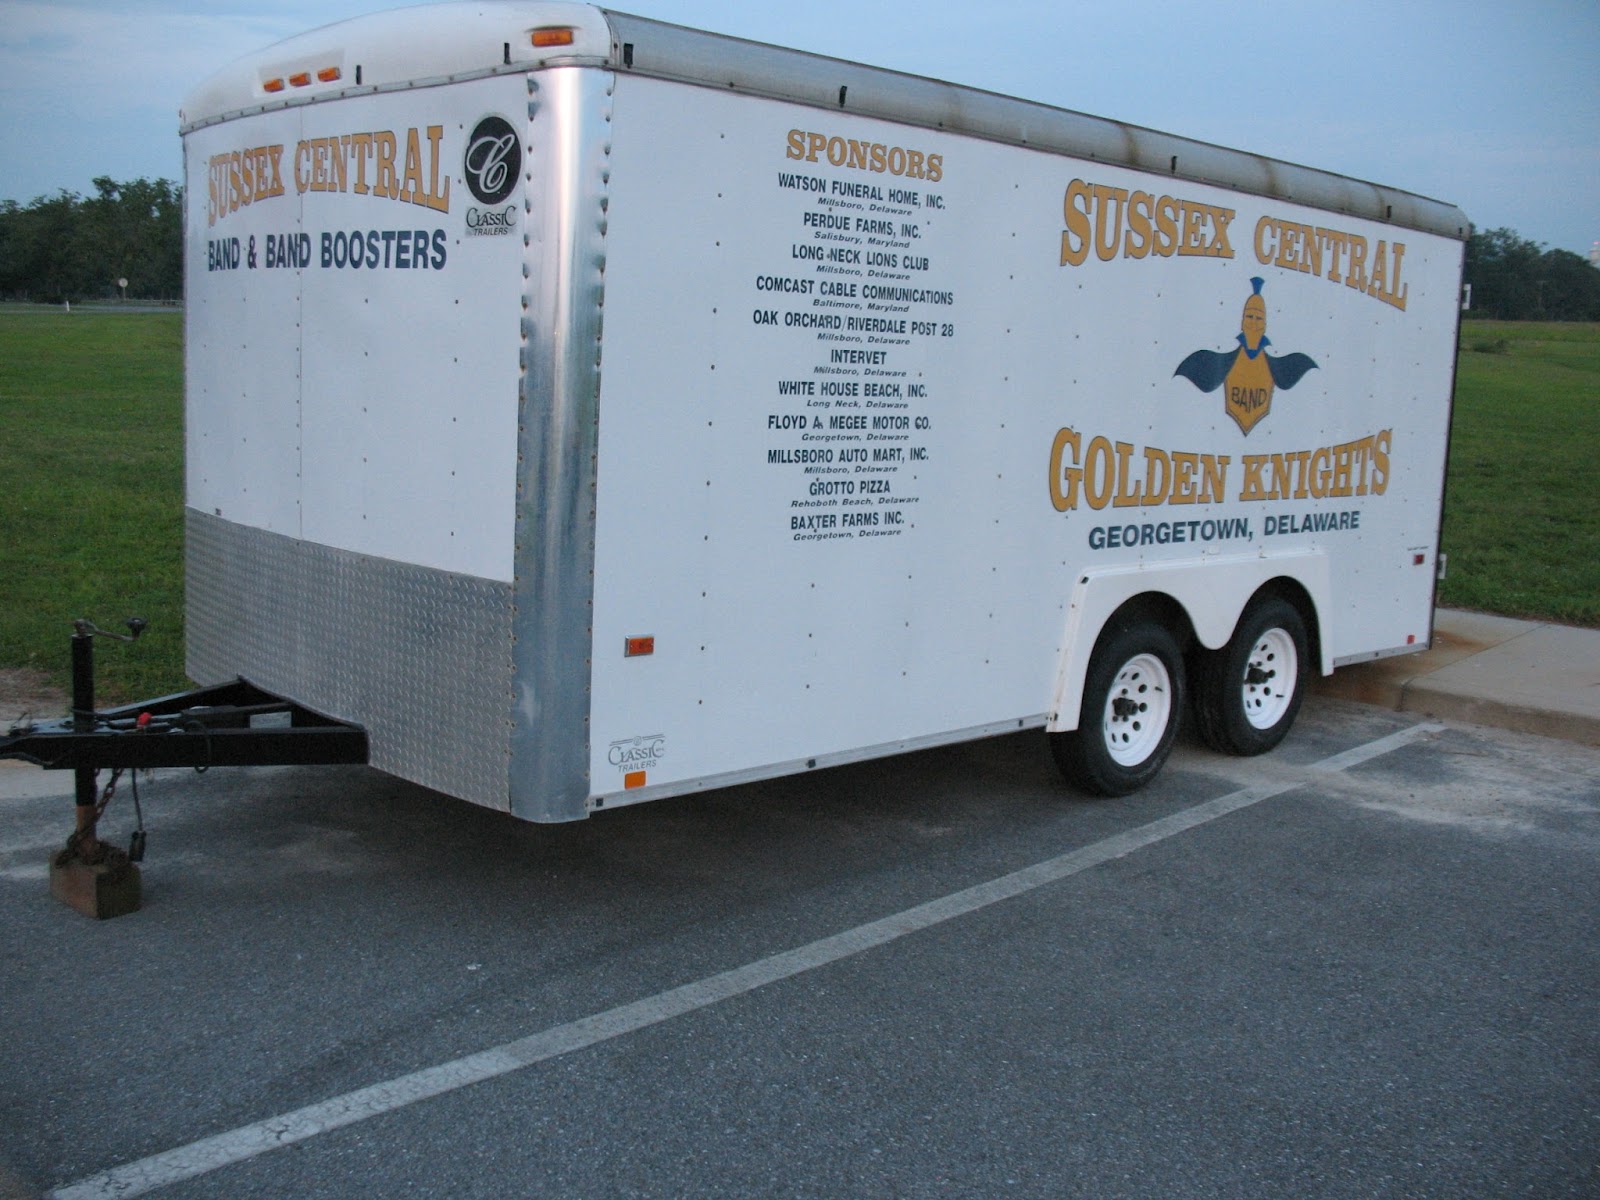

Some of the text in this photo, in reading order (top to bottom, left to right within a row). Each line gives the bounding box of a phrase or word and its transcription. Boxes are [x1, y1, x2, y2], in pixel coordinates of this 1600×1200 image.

[786, 129, 943, 182] SPONSORS
[208, 125, 450, 228] SUSSEX CENTRAL
[778, 173, 946, 209] WATSON FUNERAL HOME, INC.
[818, 197, 912, 216] Millsboro, Delaware
[474, 227, 508, 236] TRAILERS
[804, 212, 922, 239] PERDUE FARMS, INC.
[814, 231, 910, 249] Salisbury, Maryland
[1060, 178, 1408, 312] SUSSEX CENTRAL
[208, 229, 447, 271] BAND & BAND BOOSTERS
[792, 244, 929, 271] LONG NECK LIONS CLUB
[817, 265, 910, 281] Millsboro, Delaware
[756, 276, 954, 305] COMCAST CABLE COMMUNICATIONS
[813, 299, 910, 313] Baltimore, Maryland
[753, 309, 954, 337] OAK ORCHARD/RIVERDALE POST 28
[817, 333, 910, 345] Millsboro, Delaware
[831, 350, 887, 365] INTERVET
[814, 366, 907, 377] Millsboro, Delaware
[779, 381, 928, 400] WHITE HOUSE BEACH, INC.
[1231, 386, 1267, 412] BAND
[807, 400, 830, 409] Long
[835, 401, 862, 409] Neck,
[768, 415, 807, 429] FLOYD
[830, 416, 867, 429] MEGEE
[873, 417, 910, 429] MOTOR
[914, 417, 932, 430] CO.
[802, 434, 862, 442] Georgetown,
[768, 448, 929, 463] MILLSBORO AUTO MART, INC.
[804, 466, 850, 474] Millsboro,
[1049, 427, 1393, 512] GOLDEN KNIGHTS
[809, 480, 890, 495] GROTTO PIZZA
[791, 496, 919, 508] Rehoboth Beach, Delaware
[791, 511, 905, 529] BAXTER FARMS INC.
[793, 529, 901, 541] Georgetown, Delaware
[1088, 511, 1361, 550] GEORGETOWN, DELAWARE
[618, 759, 657, 773] TRAILERS
